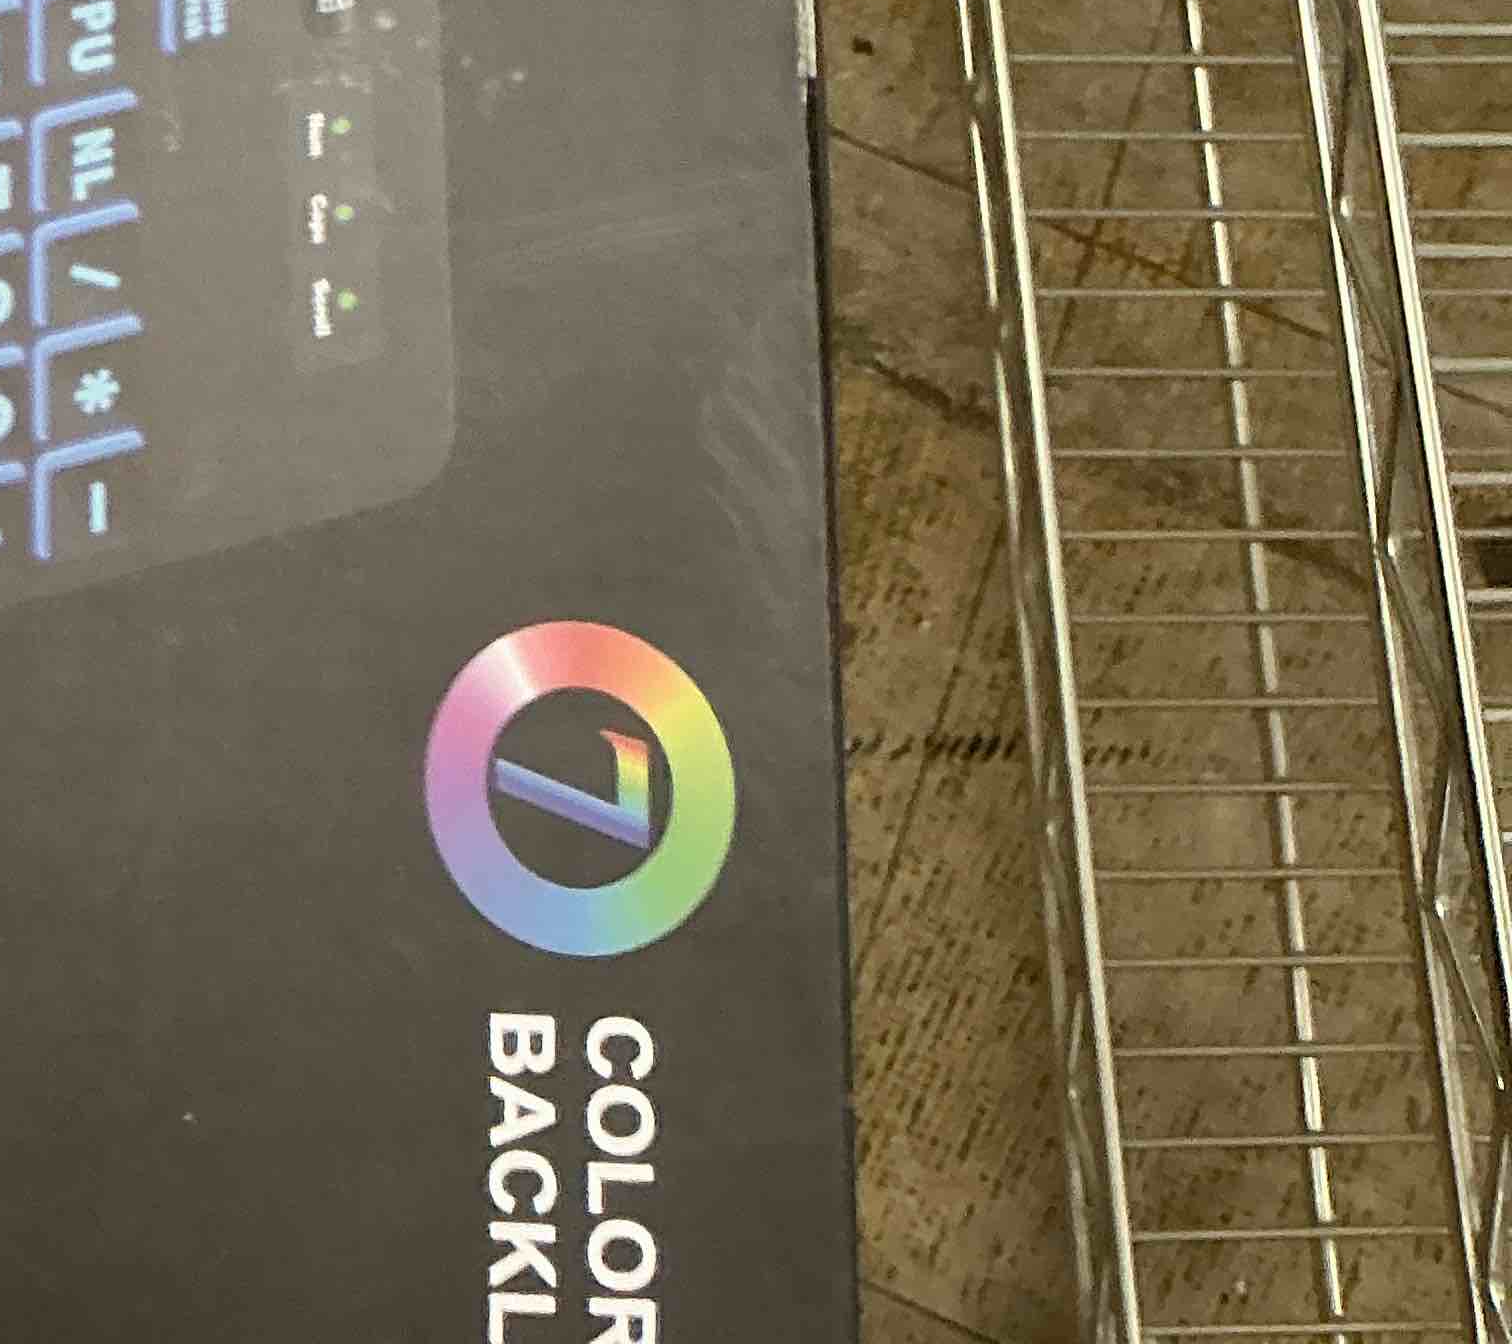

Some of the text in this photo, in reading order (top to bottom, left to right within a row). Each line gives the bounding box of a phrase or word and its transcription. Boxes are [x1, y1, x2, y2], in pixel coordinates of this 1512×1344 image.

[68, 0, 114, 72] PU
[71, 127, 114, 202] NL
[486, 1012, 557, 1344] BACKL
[585, 1016, 656, 1344] COLOR
